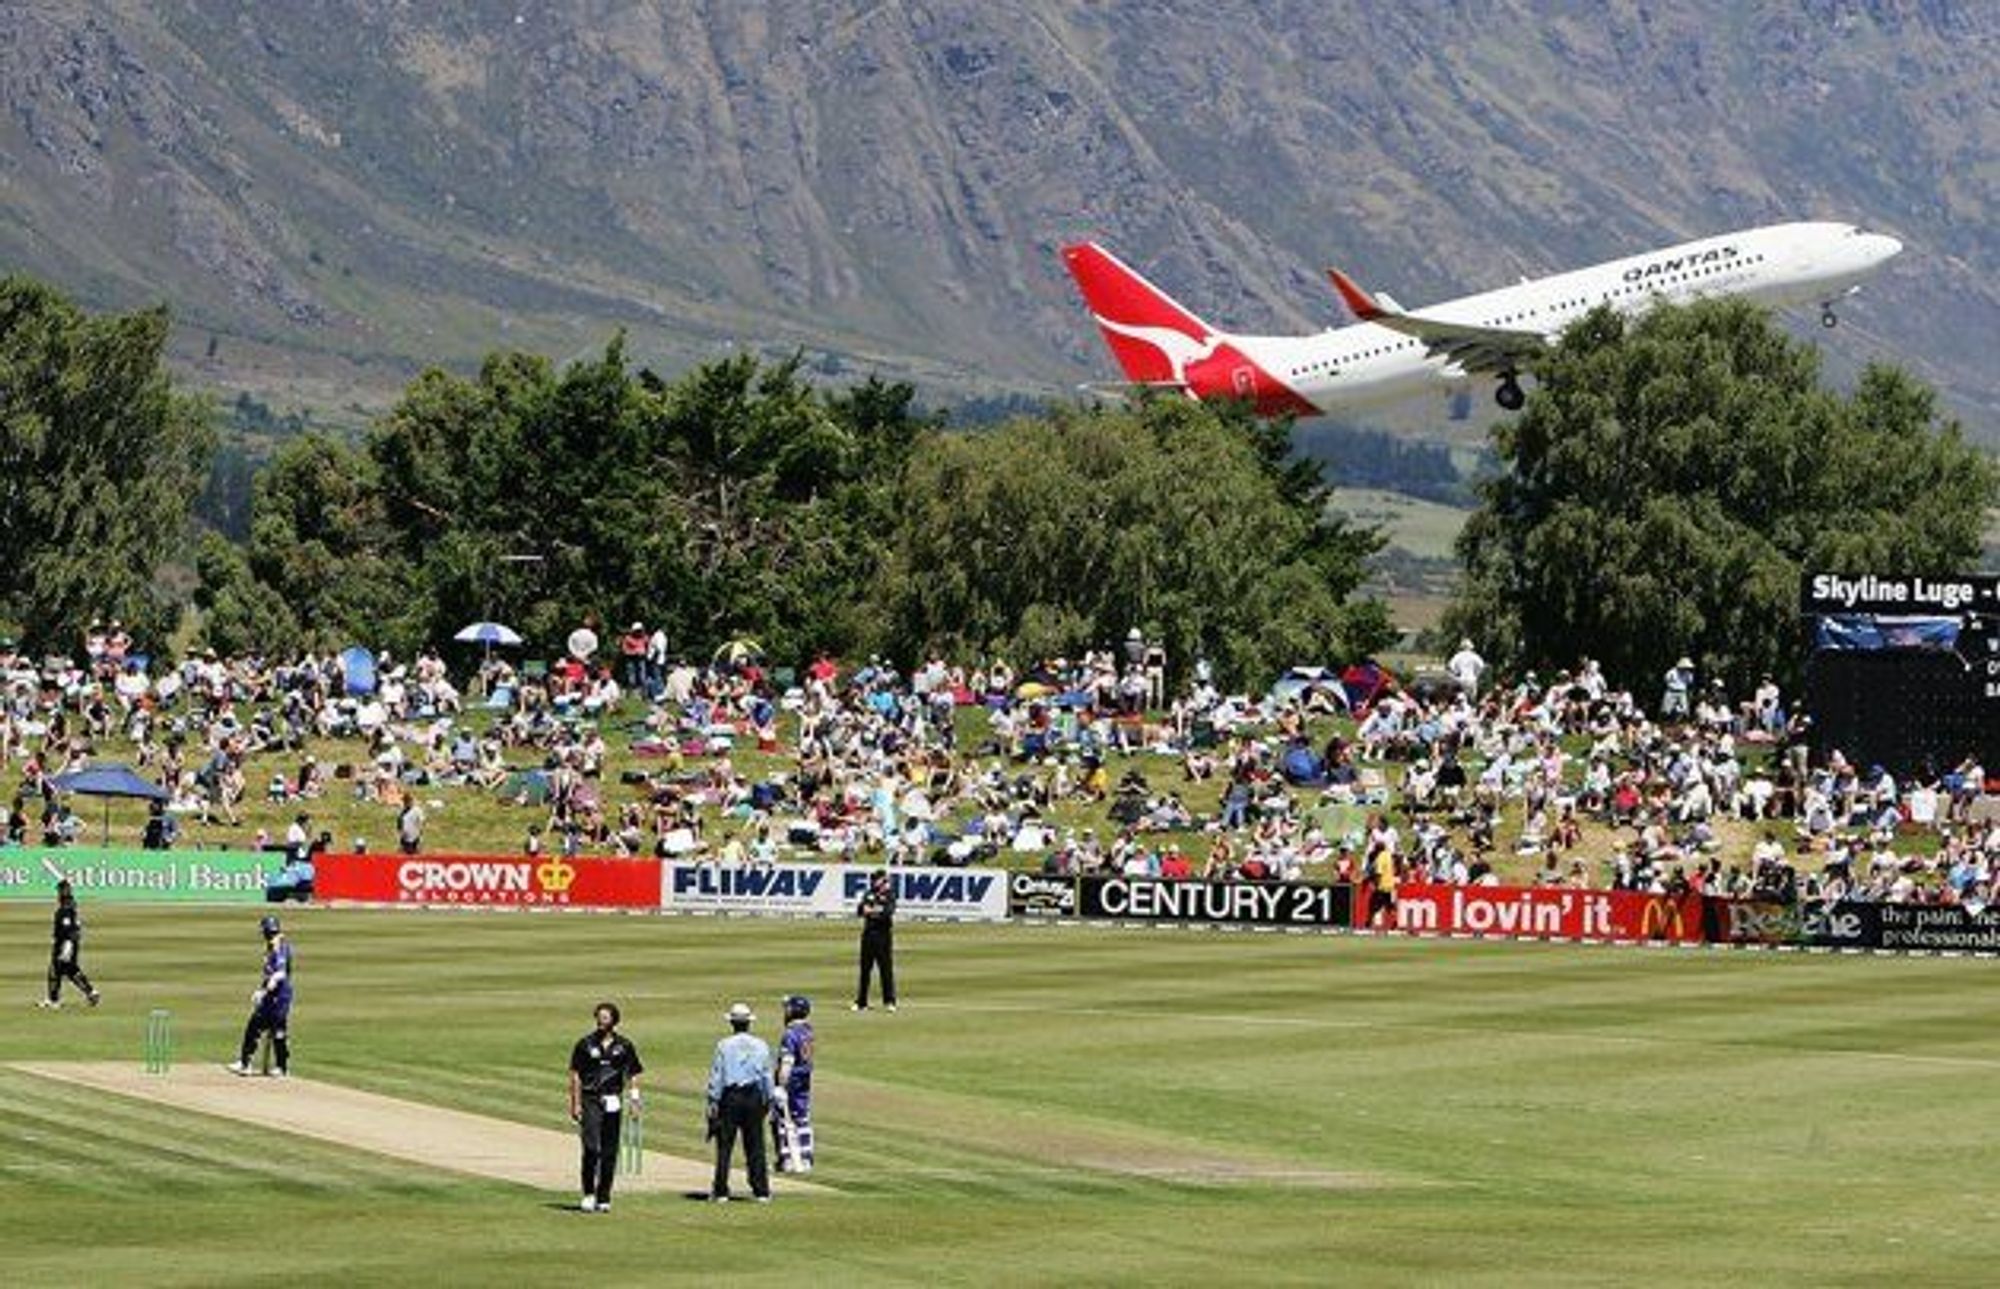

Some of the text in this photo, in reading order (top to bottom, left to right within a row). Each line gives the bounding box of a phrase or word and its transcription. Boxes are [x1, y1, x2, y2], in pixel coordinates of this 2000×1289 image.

[1623, 247, 1738, 282] QANTAS
[1812, 575, 1908, 607] Skyline
[1914, 578, 1973, 608] Luge
[190, 863, 267, 890] Bank
[398, 861, 531, 890] CROWN
[674, 867, 824, 897] FLIWAY
[844, 873, 994, 902] FIWAY
[1100, 879, 1331, 920] CENTURY 21
